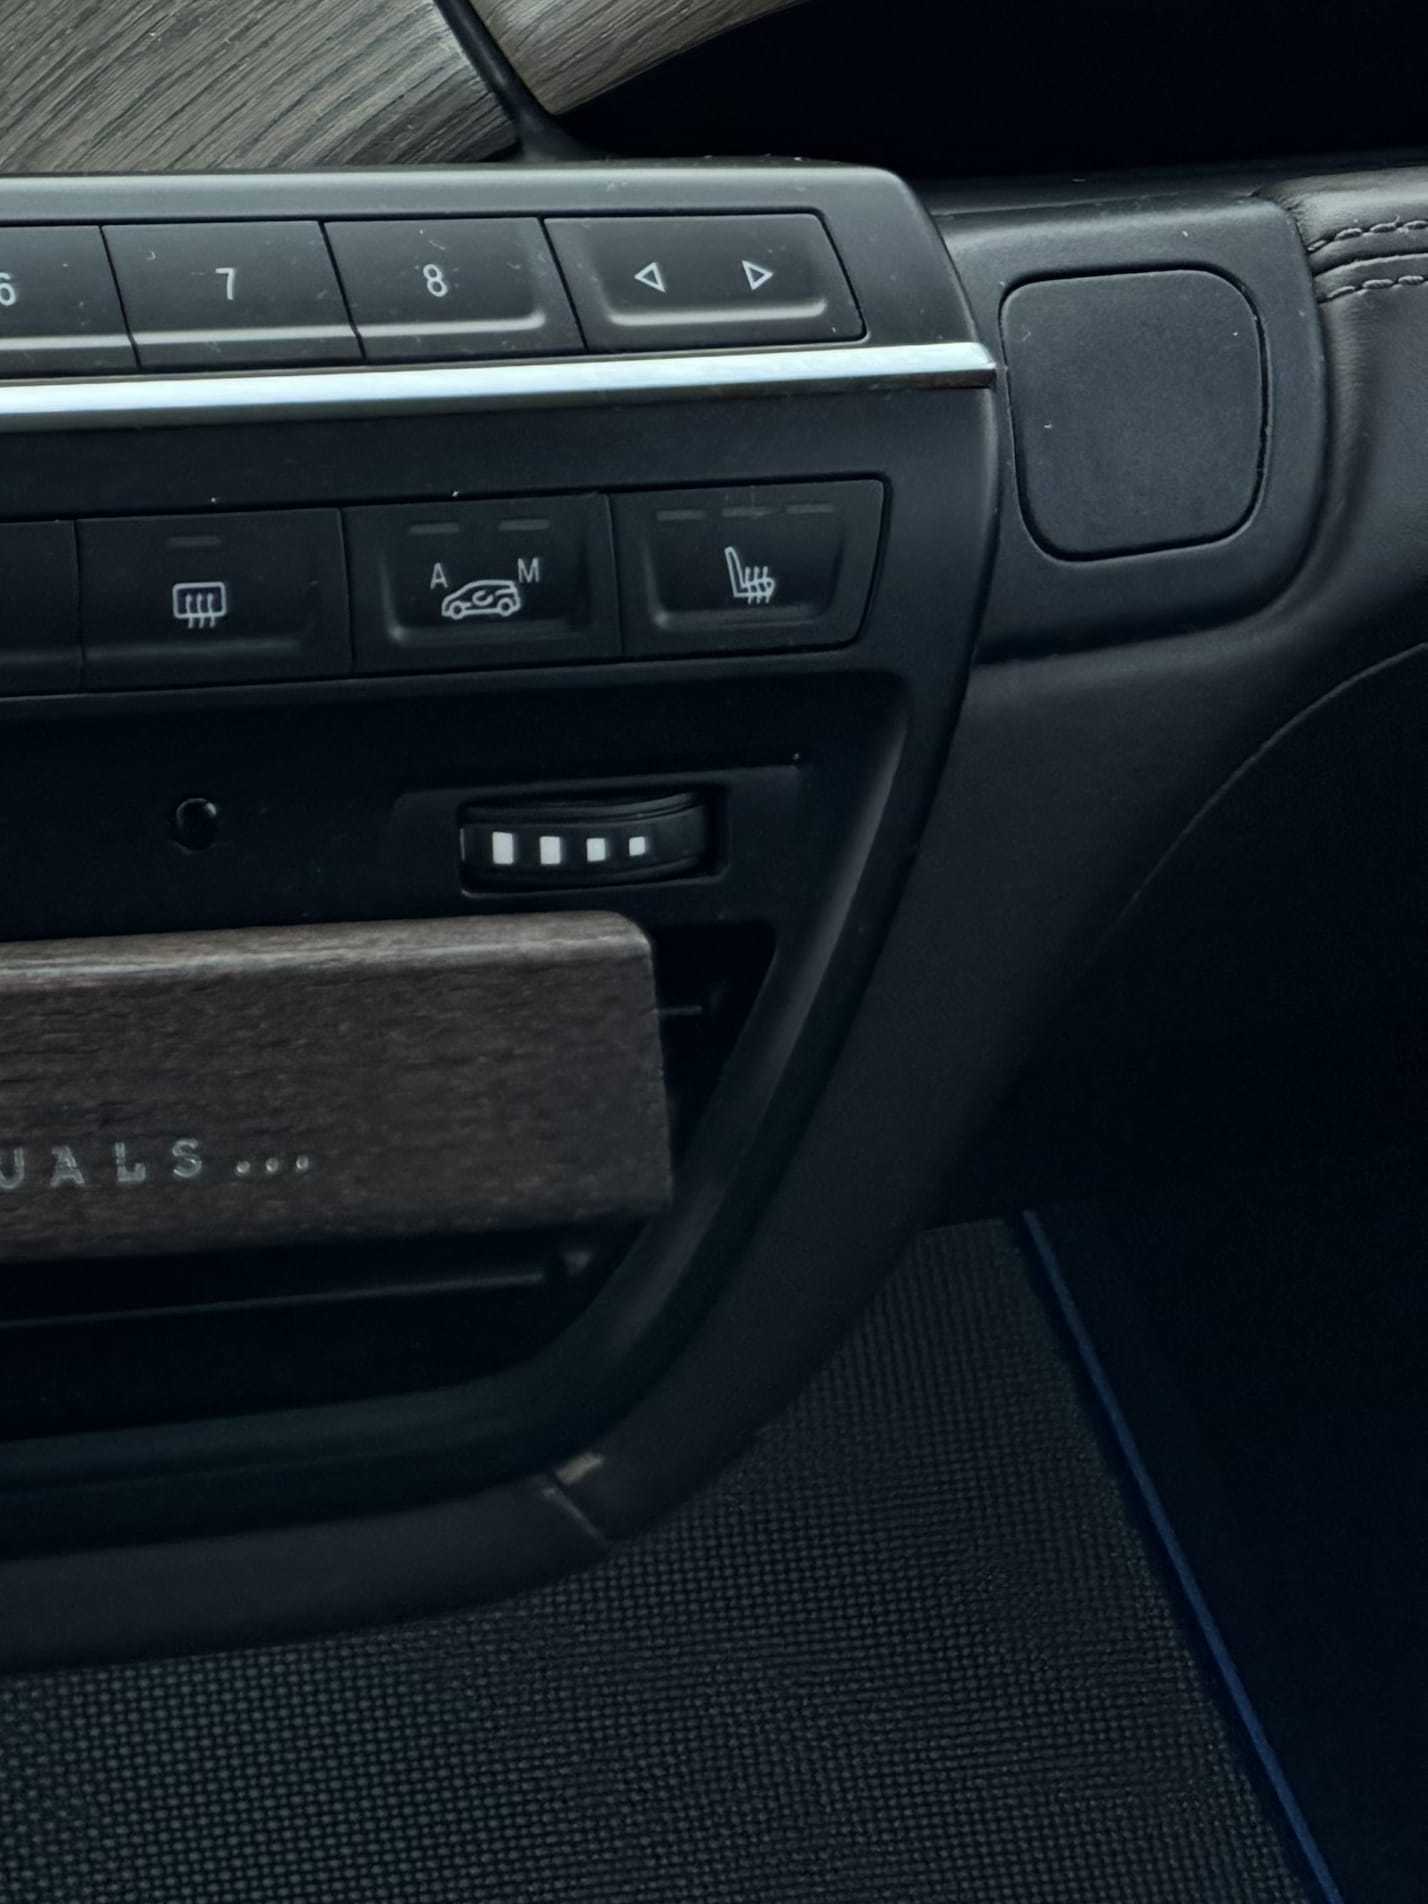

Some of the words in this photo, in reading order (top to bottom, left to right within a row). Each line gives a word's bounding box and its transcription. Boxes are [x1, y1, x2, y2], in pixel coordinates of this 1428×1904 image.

[215, 267, 236, 300] 7
[422, 263, 448, 297] 8
[430, 562, 448, 589] A
[517, 557, 540, 582] M
